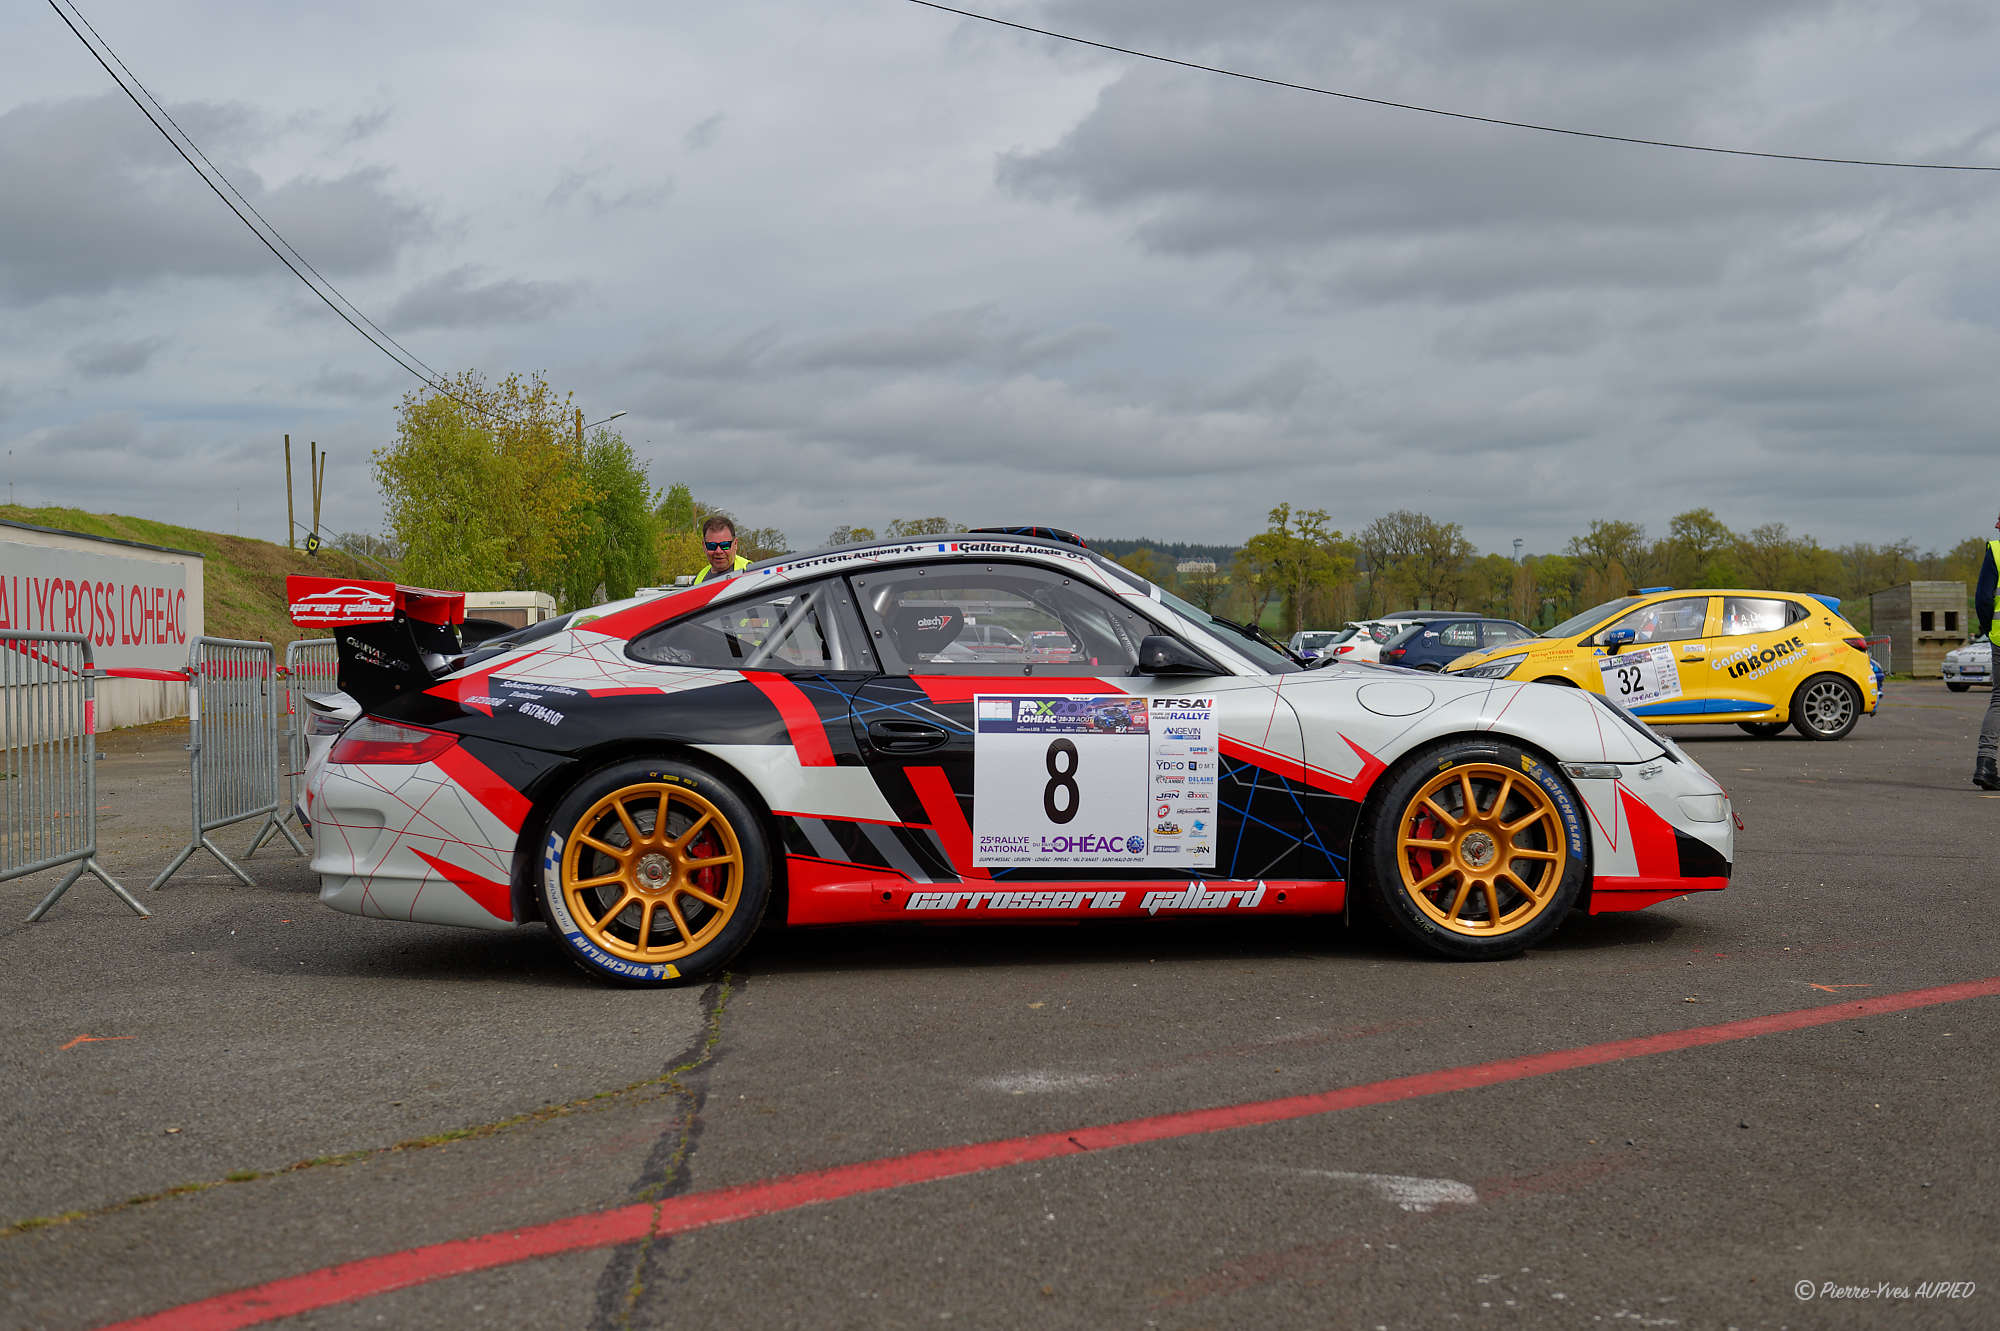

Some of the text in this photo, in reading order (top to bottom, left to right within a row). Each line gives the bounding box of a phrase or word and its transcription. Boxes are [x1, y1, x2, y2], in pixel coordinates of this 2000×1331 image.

[121, 584, 186, 647] LOHEAC
[1711, 643, 1759, 671] Garage
[1727, 636, 1805, 679] LABORIE
[1748, 647, 1808, 681] Christophe
[1617, 666, 1645, 695] 32
[1018, 700, 1056, 716] RX
[1152, 699, 1207, 708] FFSA
[1170, 712, 1211, 720] RALLYE
[1017, 715, 1057, 724] LOHEAC
[1044, 738, 1080, 825] 8
[1543, 777, 1581, 853] MICHELIN
[979, 845, 1030, 853] NATIONAL
[995, 836, 1030, 844] RALLYE
[1041, 833, 1124, 853] LOHÉAC
[905, 880, 1266, 917] carrosserie gallard
[572, 936, 649, 977] MICHELIN
